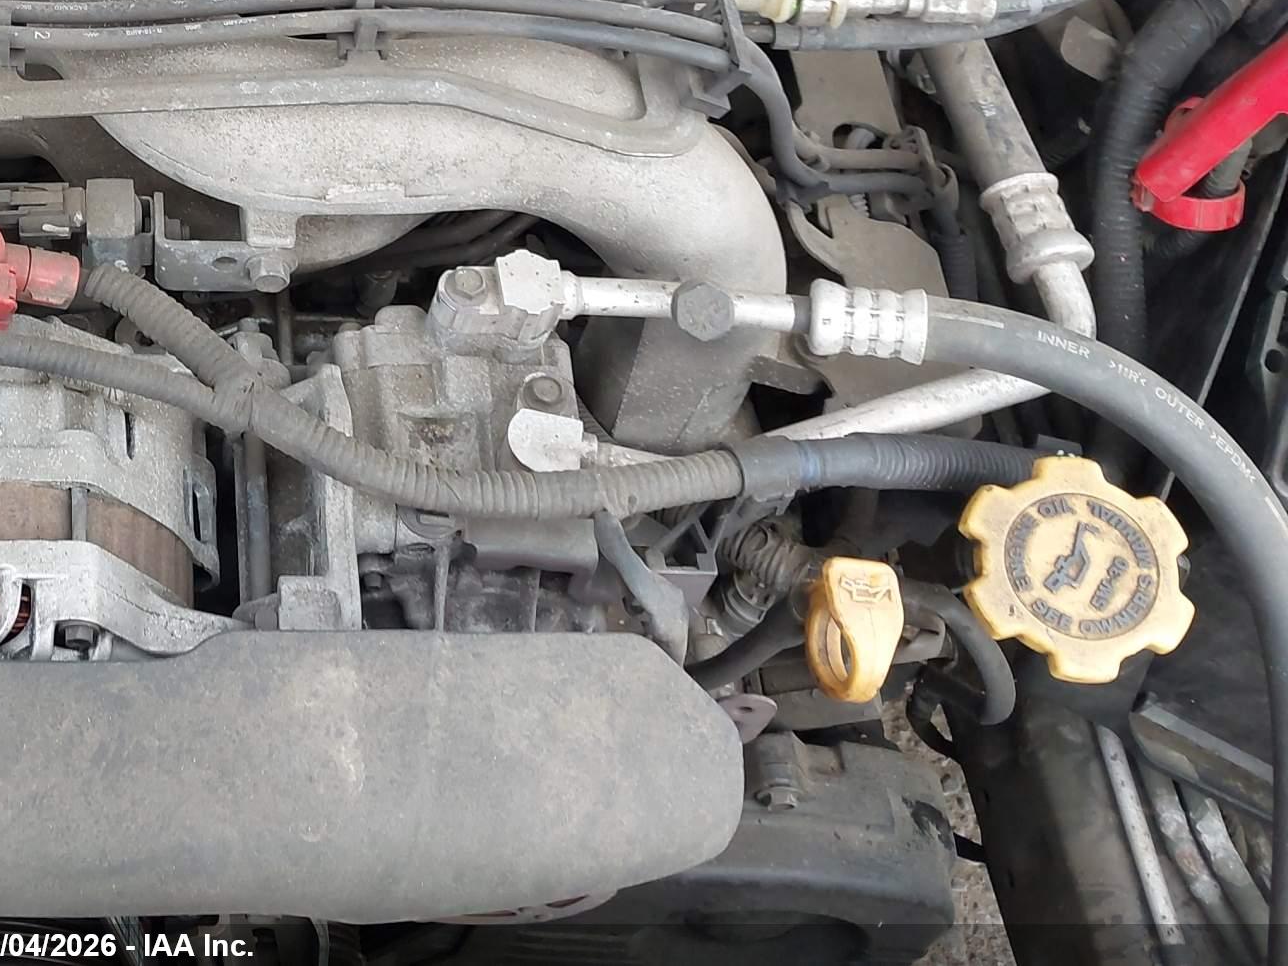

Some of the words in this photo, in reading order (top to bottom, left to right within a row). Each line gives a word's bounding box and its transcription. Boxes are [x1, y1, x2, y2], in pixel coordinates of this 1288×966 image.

[1038, 330, 1090, 359] INNER
[1155, 386, 1205, 431] OUTER
[1005, 514, 1037, 593] ENGINE
[1038, 497, 1077, 520] OIL
[1031, 599, 1073, 633] SEE
[1087, 500, 1153, 569] MANUAL
[1090, 555, 1130, 612] 5W-30
